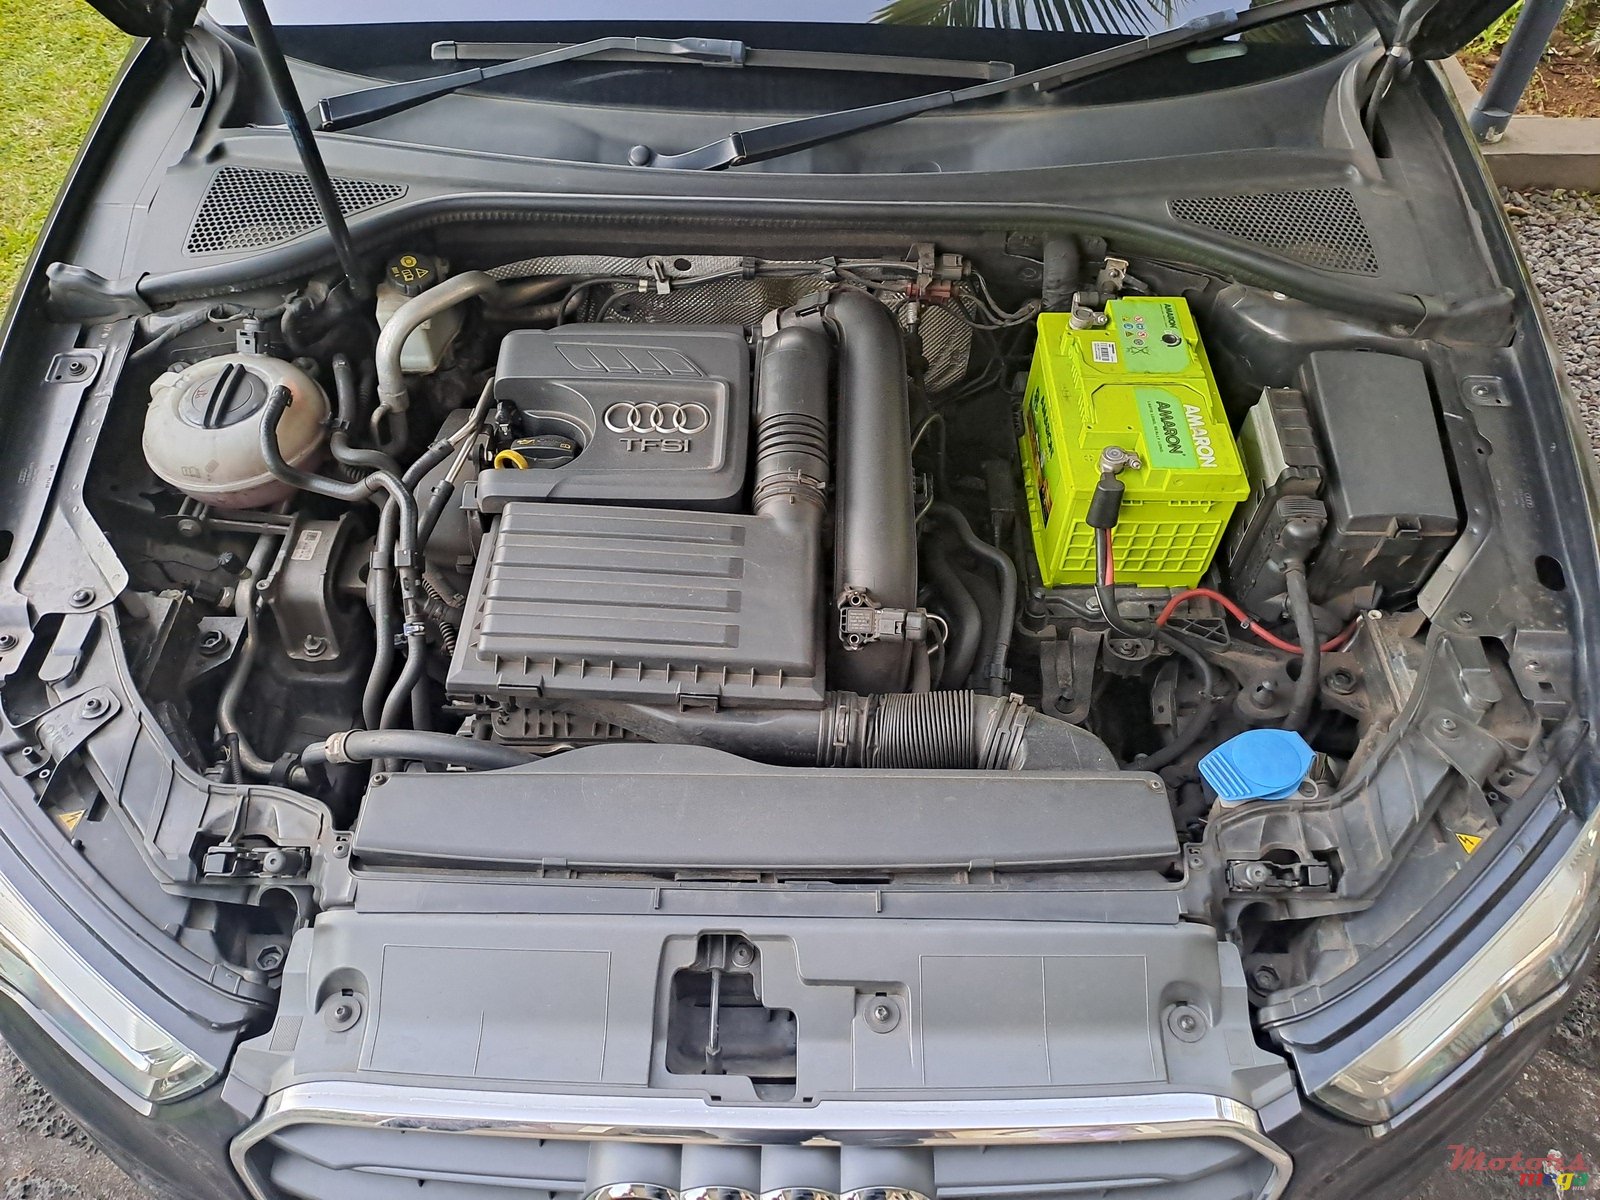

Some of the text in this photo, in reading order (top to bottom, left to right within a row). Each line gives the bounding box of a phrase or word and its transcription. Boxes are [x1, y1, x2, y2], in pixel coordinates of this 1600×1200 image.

[1164, 303, 1178, 329] AMARON
[619, 438, 691, 453] TFSI
[1156, 401, 1184, 455] AMARON
[1183, 404, 1218, 468] AMARON
